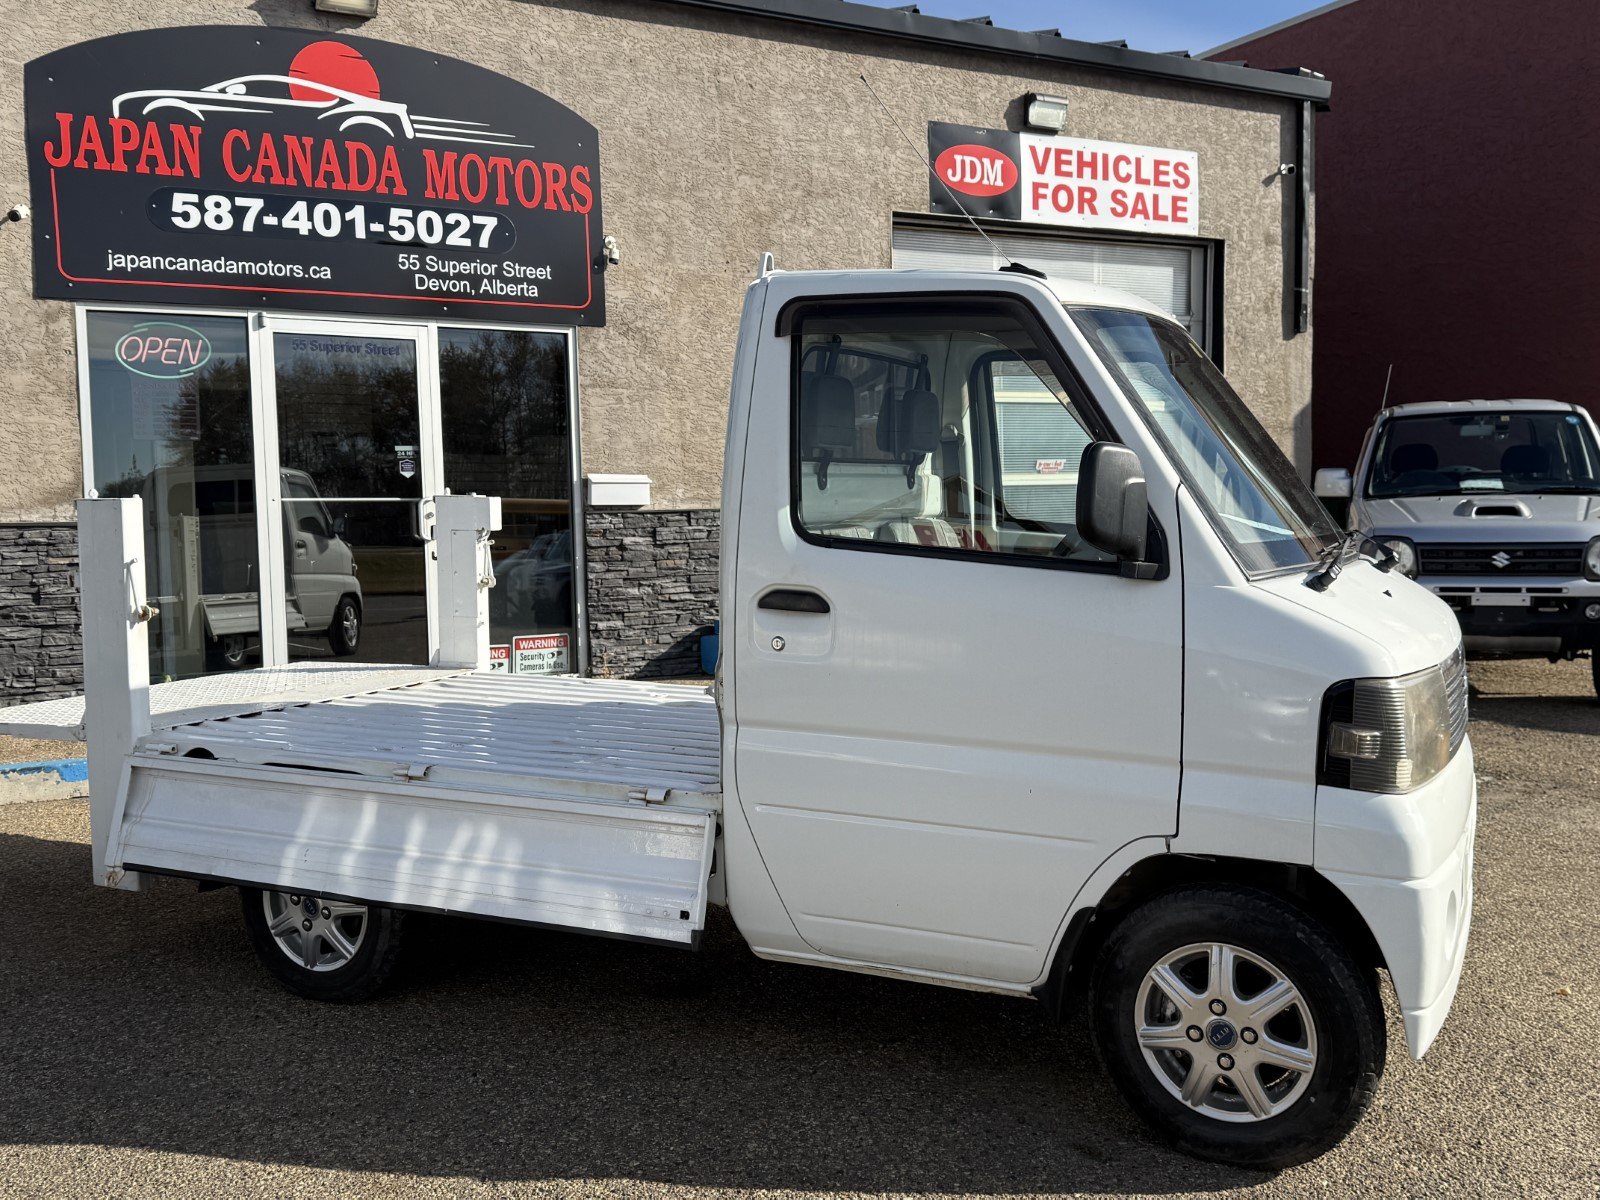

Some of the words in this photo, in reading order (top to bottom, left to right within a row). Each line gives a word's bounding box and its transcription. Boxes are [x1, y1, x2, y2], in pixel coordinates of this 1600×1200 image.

[44, 112, 202, 179] JAPAN
[222, 128, 407, 196] CANADA
[424, 149, 593, 214] MOTORS
[947, 154, 1004, 187] JDM
[1029, 145, 1190, 189] VEHICLES
[1032, 181, 1098, 216] FOR
[1110, 189, 1188, 223] SALE
[170, 193, 498, 249] 587-401-5027
[106, 249, 332, 280] japancanadamotors.ca
[398, 254, 420, 270] 55
[425, 255, 498, 276] Superior
[503, 261, 552, 280] Street
[414, 274, 475, 295] Devon,
[479, 278, 538, 297] Alberta
[121, 336, 202, 364] OPEN
[292, 339, 307, 351] 55
[309, 340, 362, 355] Superior
[365, 343, 400, 355] Street
[519, 638, 564, 649] WARNING
[519, 652, 546, 661] Security
[519, 662, 545, 671] Cameras
